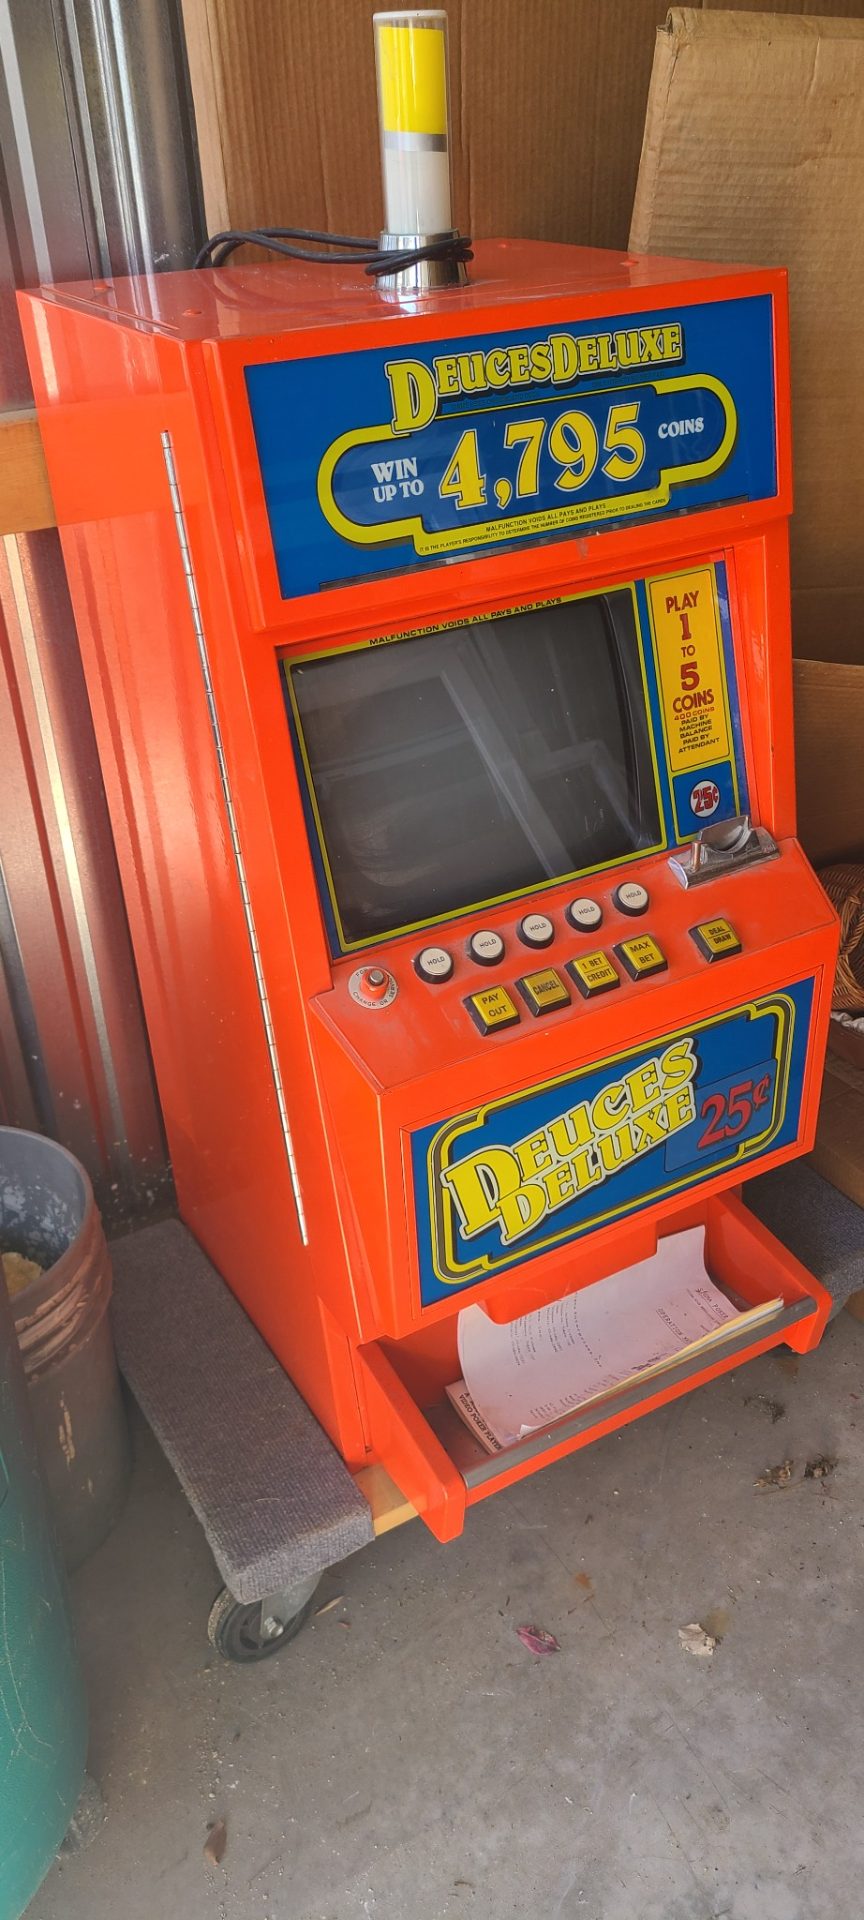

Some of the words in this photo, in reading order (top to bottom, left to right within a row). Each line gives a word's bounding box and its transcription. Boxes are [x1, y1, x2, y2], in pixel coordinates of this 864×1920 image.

[658, 417, 704, 439] COINS
[439, 402, 647, 510] 4,795
[371, 457, 418, 484] WIN
[372, 484, 397, 503] UP
[398, 480, 425, 498] TO
[486, 518, 528, 532] MALFUNCTION
[528, 516, 546, 524] VOIDS
[588, 503, 606, 512] PLAYS
[666, 590, 700, 614] PLAY
[369, 625, 440, 646] MALFUNCTION
[442, 618, 470, 628] VOIDS
[471, 614, 489, 622] ALL
[490, 608, 512, 618] PAYS
[514, 604, 533, 613] AND
[536, 597, 562, 608] PLAYS
[680, 612, 692, 640] 1
[680, 644, 696, 658] TO
[680, 661, 700, 691] 5
[672, 688, 714, 713] COINS
[674, 712, 692, 720] 400
[692, 706, 714, 716] COINS
[679, 719, 712, 732] MACHINE
[681, 716, 698, 726] PAID
[680, 726, 712, 739] BALANCE
[678, 737, 720, 754] ATTENDANT
[682, 736, 698, 744] PAID
[626, 890, 642, 900] HOLD
[578, 906, 596, 915] HOLD
[530, 922, 547, 932] HOLD
[708, 926, 725, 936] DEAL
[480, 938, 497, 948] HOLD
[714, 934, 732, 944] DRAW
[630, 941, 651, 952] MAX
[427, 956, 446, 966] HOLD
[589, 956, 603, 968] BET
[639, 954, 656, 964] BET
[587, 968, 612, 982] CREDIT
[532, 980, 560, 996] CANCEL
[352, 992, 376, 1006] CHANGE
[482, 993, 500, 1004] PAY
[488, 1005, 508, 1017] OUT
[440, 1038, 699, 1241] DEUCES
[496, 1082, 698, 1246] DELUXE
[460, 1394, 473, 1412] VIDEO
[471, 1413, 486, 1431] POKER
